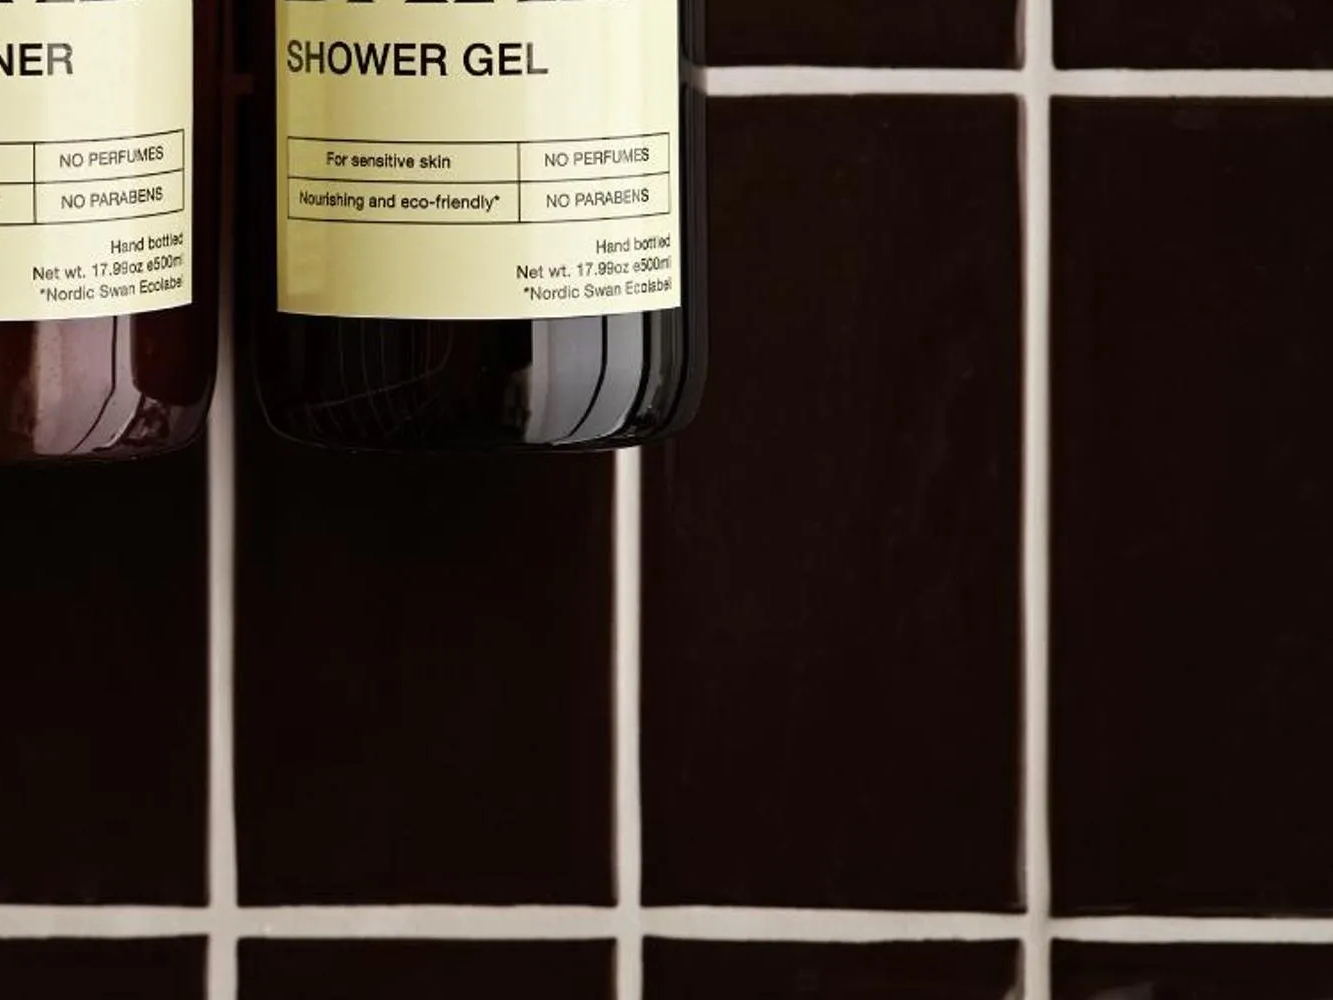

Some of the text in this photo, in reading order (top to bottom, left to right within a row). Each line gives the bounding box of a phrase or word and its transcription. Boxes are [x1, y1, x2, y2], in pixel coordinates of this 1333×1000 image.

[287, 39, 549, 77] SHOWER GEL
[59, 146, 164, 168] NO PERFUMES
[326, 152, 451, 169] For sensitive skin
[545, 148, 650, 167] NO PERFUMES
[61, 187, 163, 209] NO PARABENS
[299, 191, 364, 211] Nourishing
[368, 194, 396, 209] and
[546, 189, 650, 208] NO PARABENS
[111, 233, 184, 254] Hand bottled
[596, 234, 671, 255] Hand bottled
[33, 266, 61, 281] Net
[65, 266, 86, 280] wt.
[93, 261, 143, 278] 17.99oz
[516, 264, 544, 280] Net
[548, 265, 571, 279] wt.
[577, 261, 629, 278] 17.99oz
[99, 282, 136, 300] Swan
[584, 282, 622, 300] Swan
